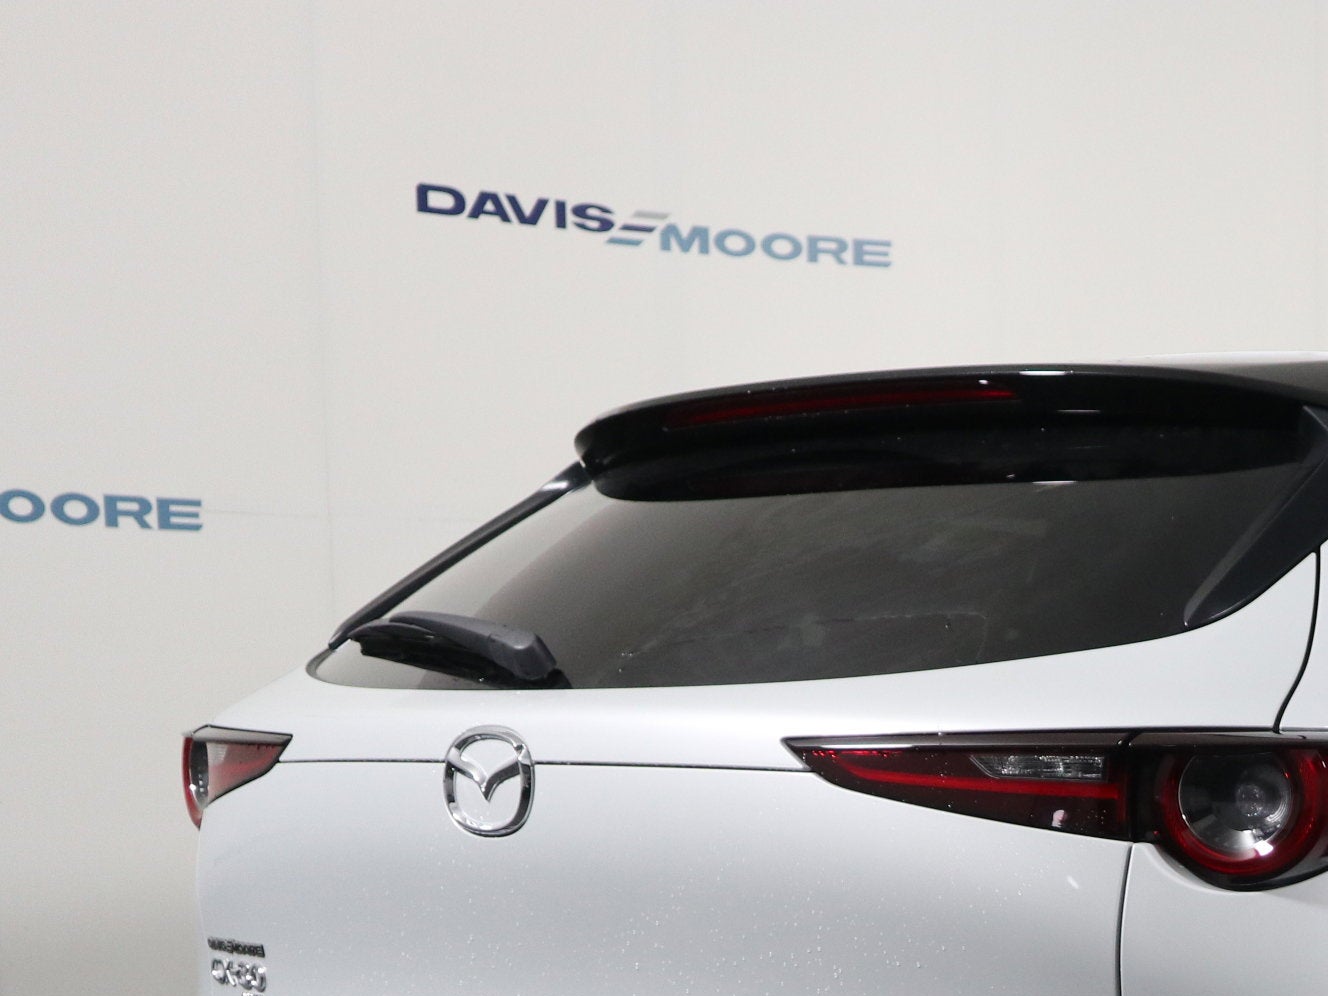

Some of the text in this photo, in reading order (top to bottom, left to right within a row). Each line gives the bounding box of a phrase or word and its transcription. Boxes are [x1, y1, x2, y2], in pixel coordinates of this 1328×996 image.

[415, 183, 893, 268] DAVIS MOORE
[0, 488, 203, 532] OORE
